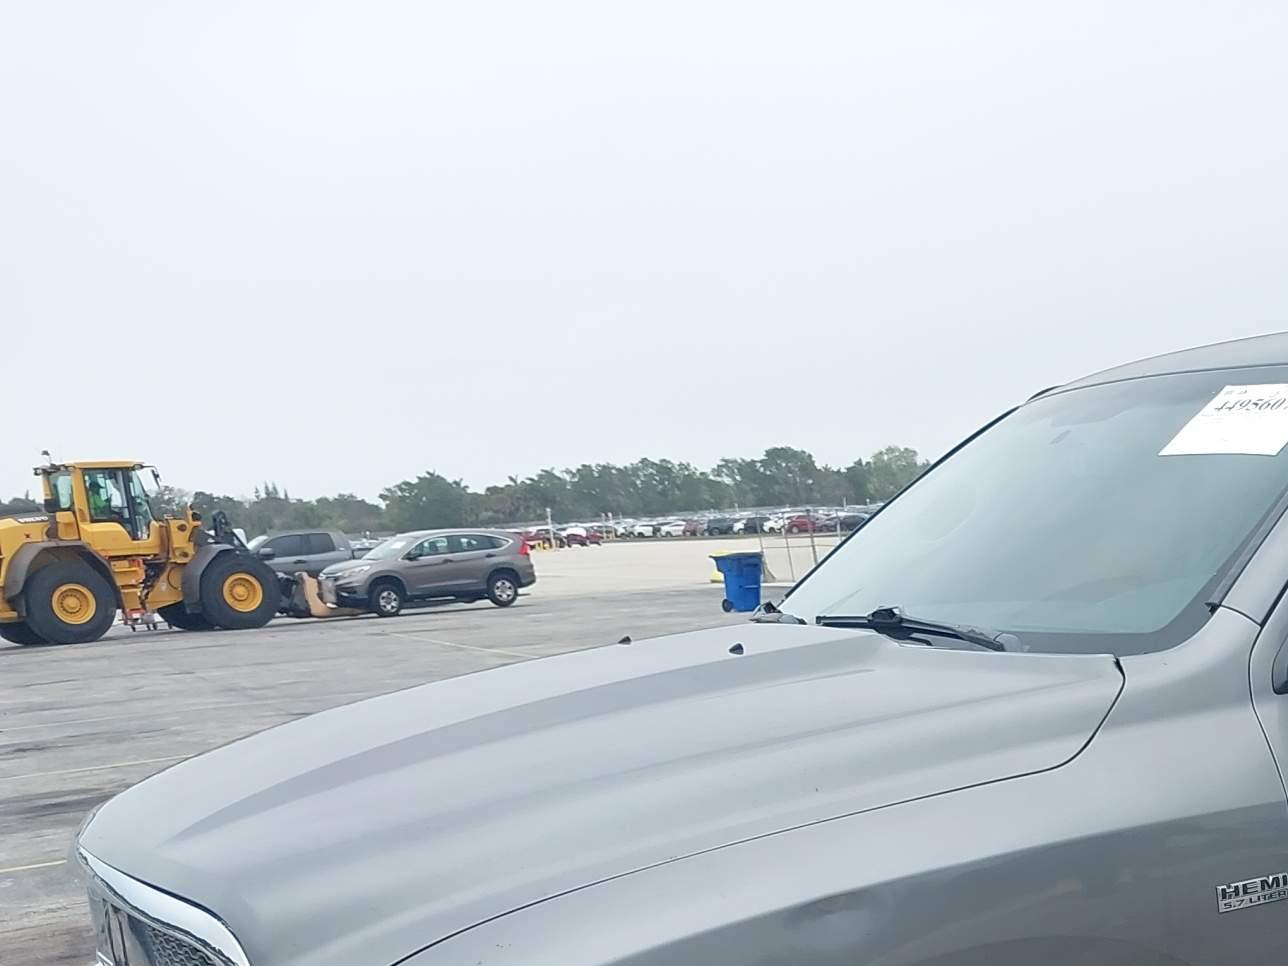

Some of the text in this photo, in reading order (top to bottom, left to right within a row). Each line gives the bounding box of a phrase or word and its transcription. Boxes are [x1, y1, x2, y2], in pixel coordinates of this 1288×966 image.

[1220, 873, 1288, 900] HEMI
[1223, 890, 1287, 909] 5.7 LITER
